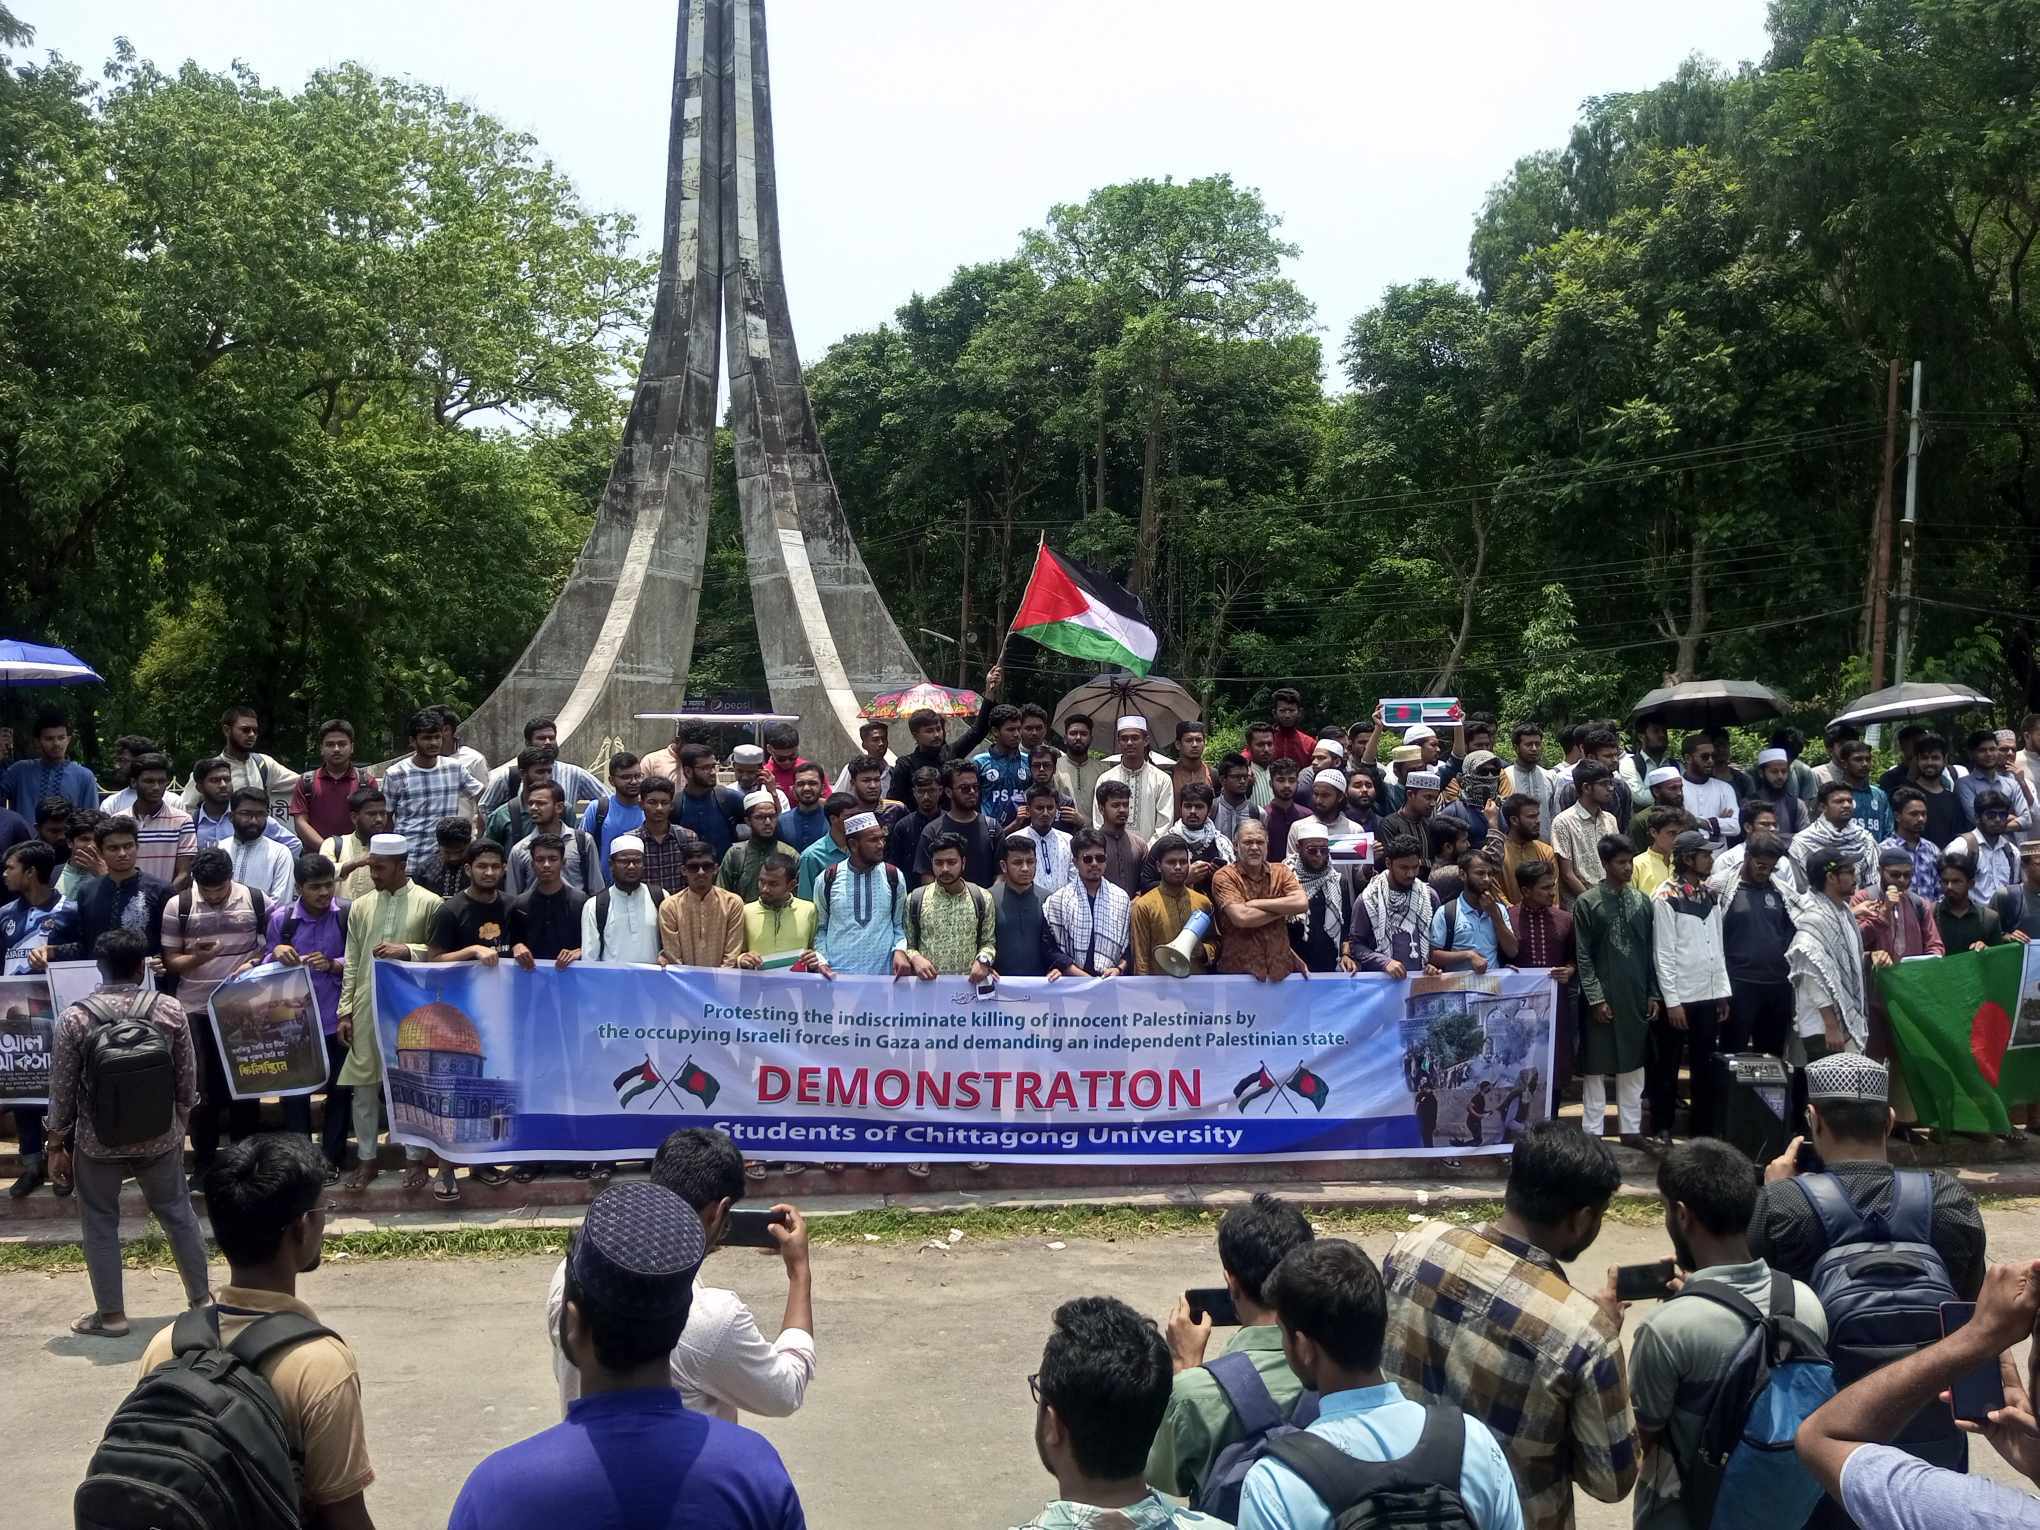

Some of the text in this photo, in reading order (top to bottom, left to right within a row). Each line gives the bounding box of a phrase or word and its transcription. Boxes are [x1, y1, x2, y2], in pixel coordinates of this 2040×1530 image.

[992, 789, 1009, 802] PS
[1868, 818, 1880, 831] 58
[703, 1003, 1256, 1030] Protesting the indiscriminate killing of innocent Palestinians by
[598, 1023, 1349, 1052] the occupying Israeli forces in Gaza and demanding an independent Palestinian state.
[757, 1065, 1201, 1110] DEMONSTRATION
[713, 1121, 1243, 1149] Students of Chittagong University
